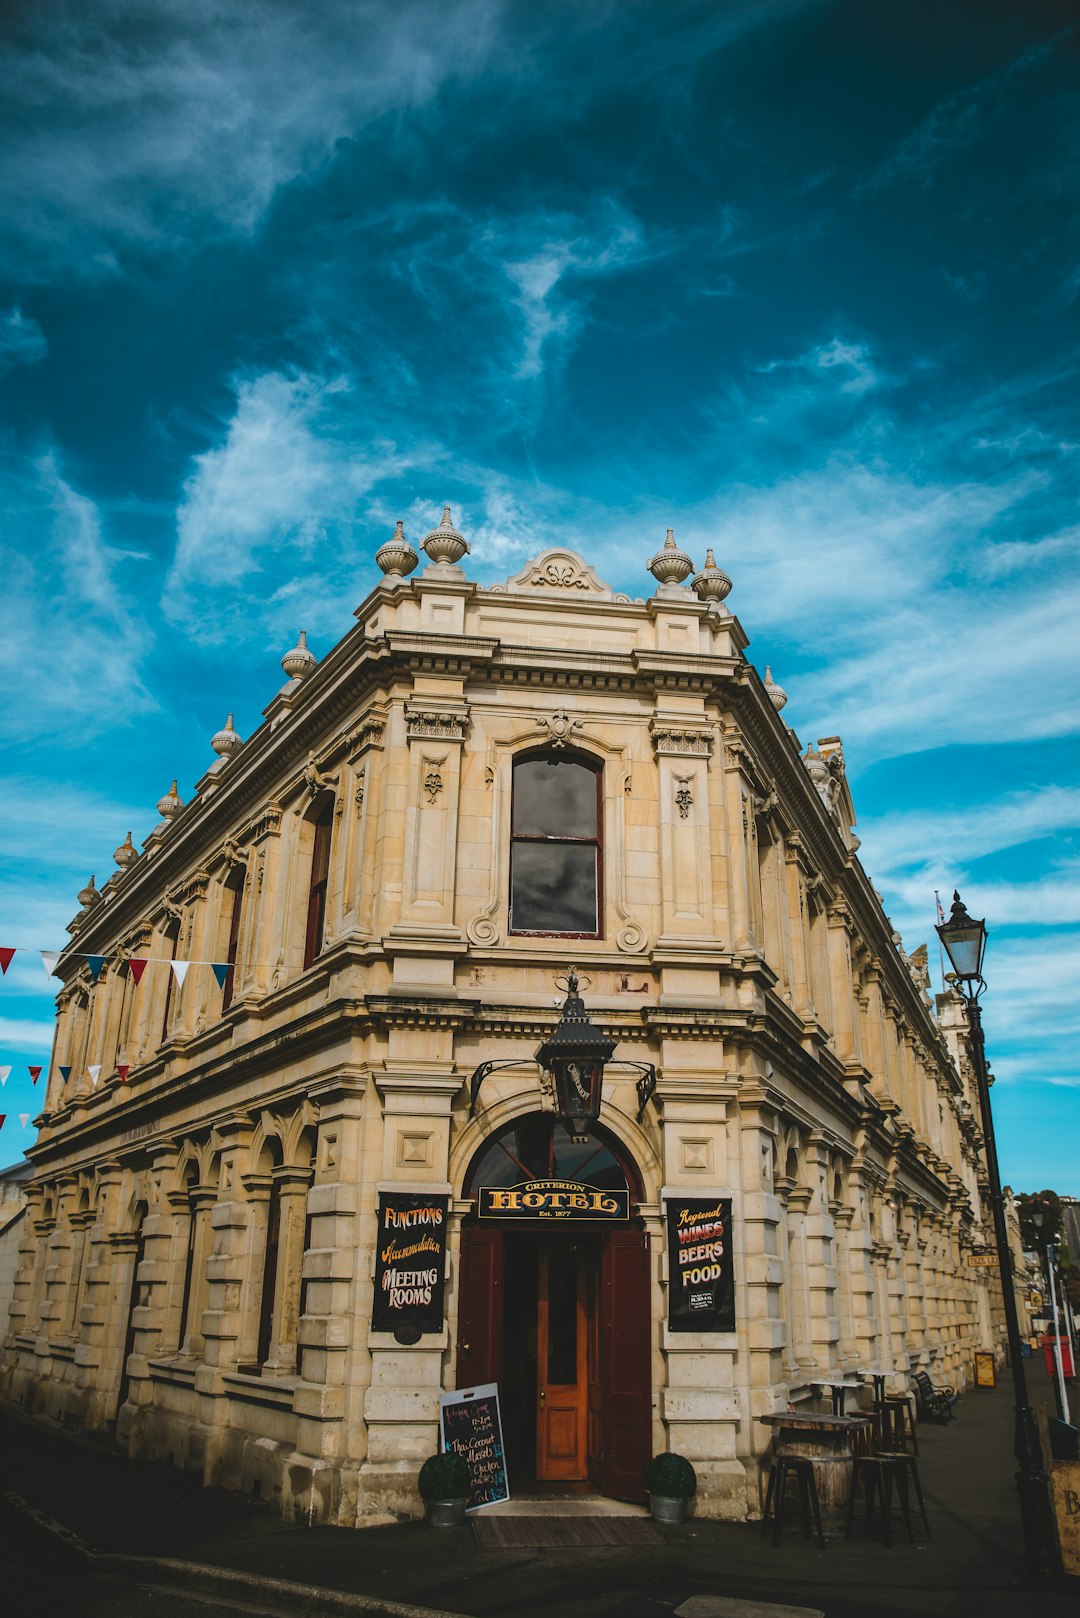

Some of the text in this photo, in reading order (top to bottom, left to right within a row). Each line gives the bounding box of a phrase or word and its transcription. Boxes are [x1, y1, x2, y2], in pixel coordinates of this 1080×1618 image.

[525, 1182, 585, 1193] CRITERION
[488, 1191, 619, 1215] HOTEL
[384, 1207, 443, 1230] FUNCTIONS
[677, 1203, 722, 1227] Regional
[678, 1221, 724, 1245] WINES
[381, 1233, 440, 1264] Accommodation
[678, 1241, 723, 1264] BEERS
[382, 1268, 438, 1291] MEETING
[682, 1264, 721, 1287] FOOD
[388, 1286, 432, 1309] ROOMS
[452, 1439, 469, 1456] Thai
[474, 1461, 500, 1474] Chicken
